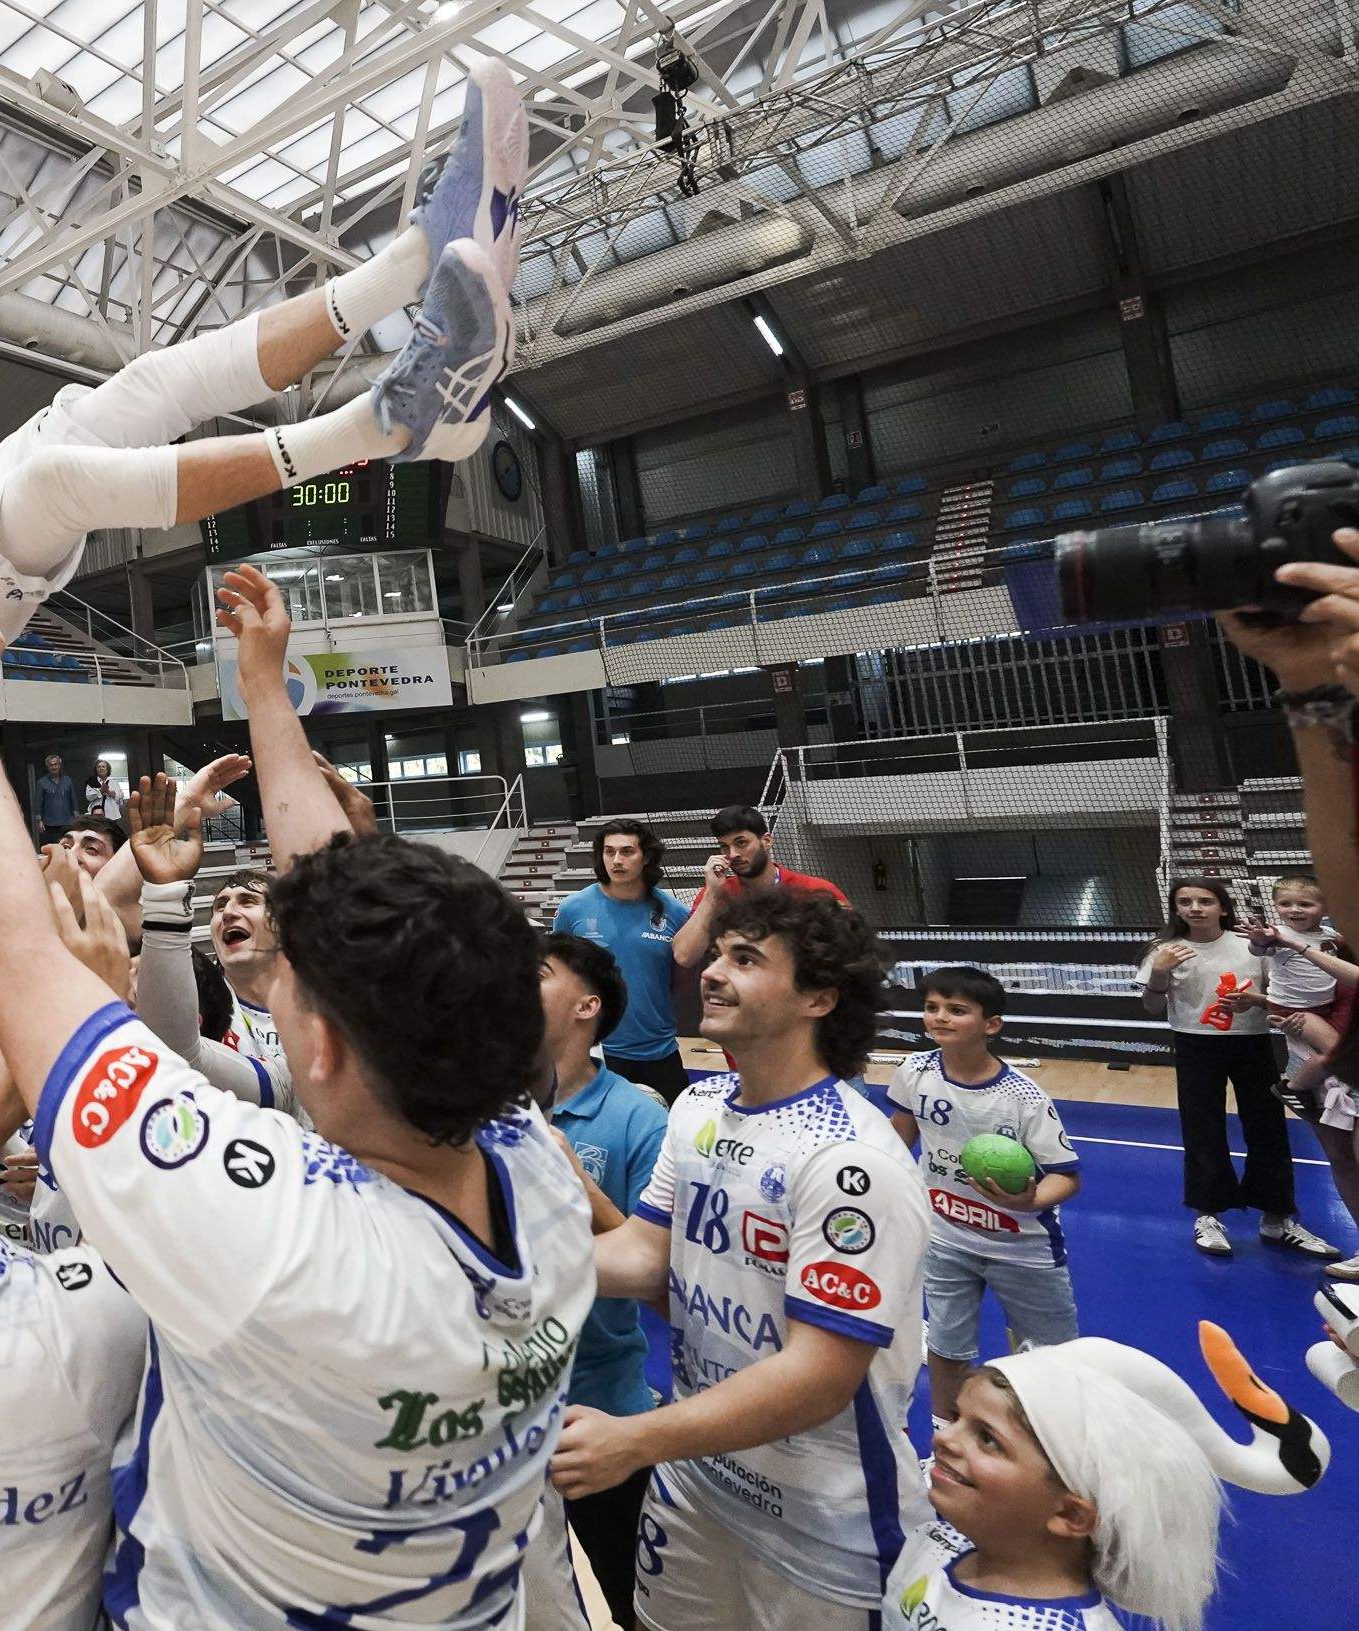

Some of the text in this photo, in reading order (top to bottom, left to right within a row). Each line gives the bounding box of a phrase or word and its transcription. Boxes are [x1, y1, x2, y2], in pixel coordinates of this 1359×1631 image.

[389, 464, 395, 472] 7
[389, 473, 395, 481] 8
[389, 481, 395, 489] 9
[292, 482, 350, 506] 30:00
[387, 489, 397, 498] 10
[386, 498, 396, 506] 11
[386, 506, 396, 515] 12
[386, 514, 396, 523] 13
[207, 520, 216, 529] 12
[385, 522, 396, 531] 14
[208, 529, 218, 537] 13
[385, 531, 395, 540] 15
[210, 537, 219, 545] 14
[211, 545, 220, 553] 15
[324, 665, 399, 678] DEPORTE
[325, 675, 435, 690] PONTEVEDRA
[914, 1094, 953, 1126] 18
[228, 1142, 270, 1184] K
[842, 1170, 867, 1193] K
[934, 1192, 1002, 1233] ABRIL
[685, 1180, 731, 1255] 18
[803, 1268, 872, 1305] AC&C
[374, 1389, 486, 1452] Los
